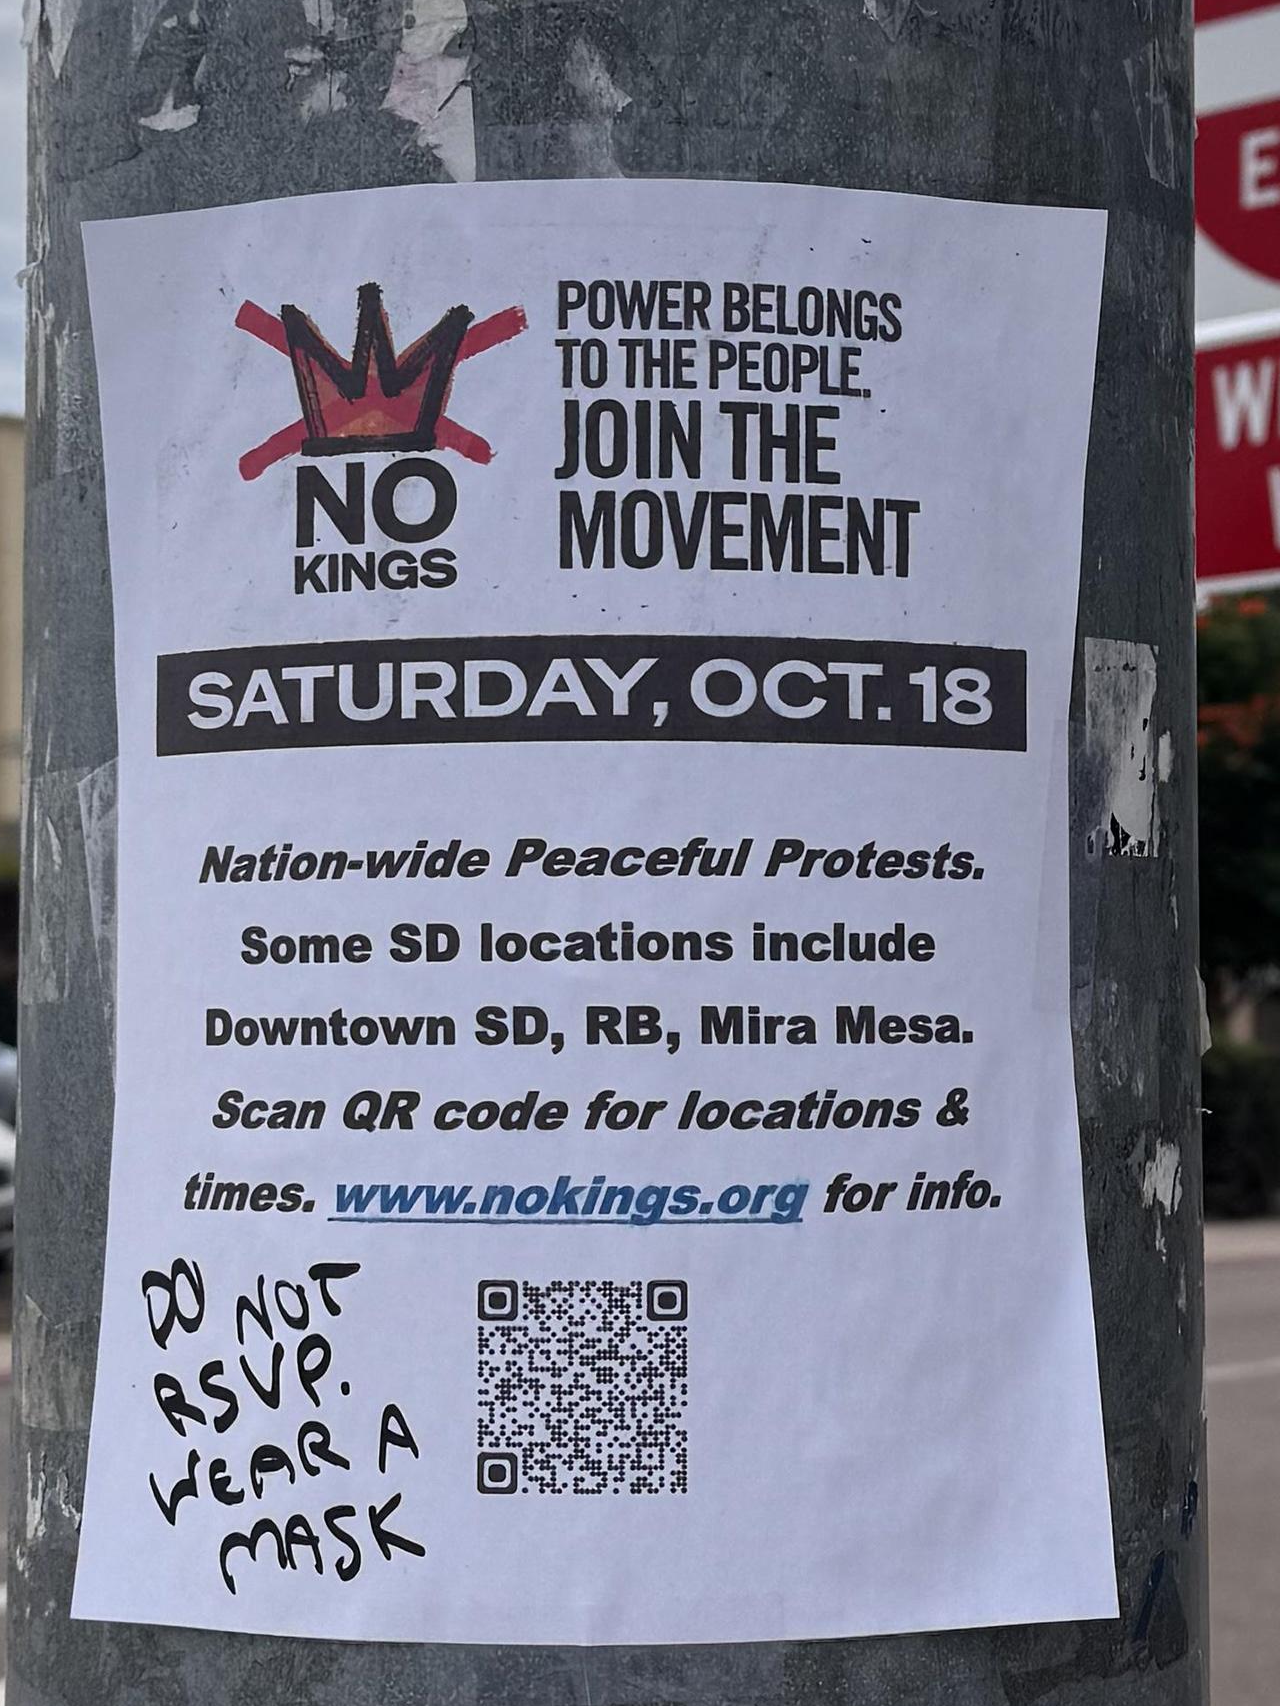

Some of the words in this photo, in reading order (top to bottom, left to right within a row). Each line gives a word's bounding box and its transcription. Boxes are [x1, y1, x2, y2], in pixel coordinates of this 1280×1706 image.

[558, 280, 711, 330] POWER
[724, 282, 902, 342] BELONGS
[555, 338, 607, 388] TO
[618, 339, 697, 389] THE
[709, 340, 871, 398] PEOPLE.
[555, 399, 701, 479] JOIN
[720, 401, 840, 484] THE
[296, 458, 457, 548] NO
[560, 490, 920, 577] MOVEMENT
[295, 548, 457, 594] KINGS
[188, 658, 668, 729] SATURDAY,
[691, 659, 891, 720] OCT.
[909, 666, 992, 725] 18
[199, 840, 490, 883] Nation-wide
[505, 837, 753, 877] Peaceful
[764, 839, 984, 879] Protests.
[241, 926, 372, 964] Some
[390, 923, 460, 962] SD
[481, 922, 733, 962] locations
[753, 922, 935, 961] include
[206, 1008, 455, 1046] Downtown
[475, 1006, 564, 1054] SD,
[587, 1006, 680, 1054] RB,
[701, 1006, 816, 1044] Mira
[836, 1006, 973, 1044] Mesa.
[213, 1090, 326, 1129] Scan
[343, 1091, 420, 1132] QR
[434, 1091, 568, 1130] code
[585, 1090, 668, 1130] for
[678, 1090, 921, 1130] locations
[936, 1088, 969, 1126] &
[184, 1172, 315, 1212] times.
[327, 1176, 809, 1226] www.nokings.org
[824, 1173, 898, 1212] for
[907, 1170, 1001, 1210] info.
[142, 1258, 205, 1350] DO
[236, 1262, 361, 1346] NOT
[154, 1334, 352, 1437] RSVP.
[150, 1421, 352, 1526] WEAR
[379, 1404, 419, 1473] A
[219, 1493, 426, 1595] MASK
